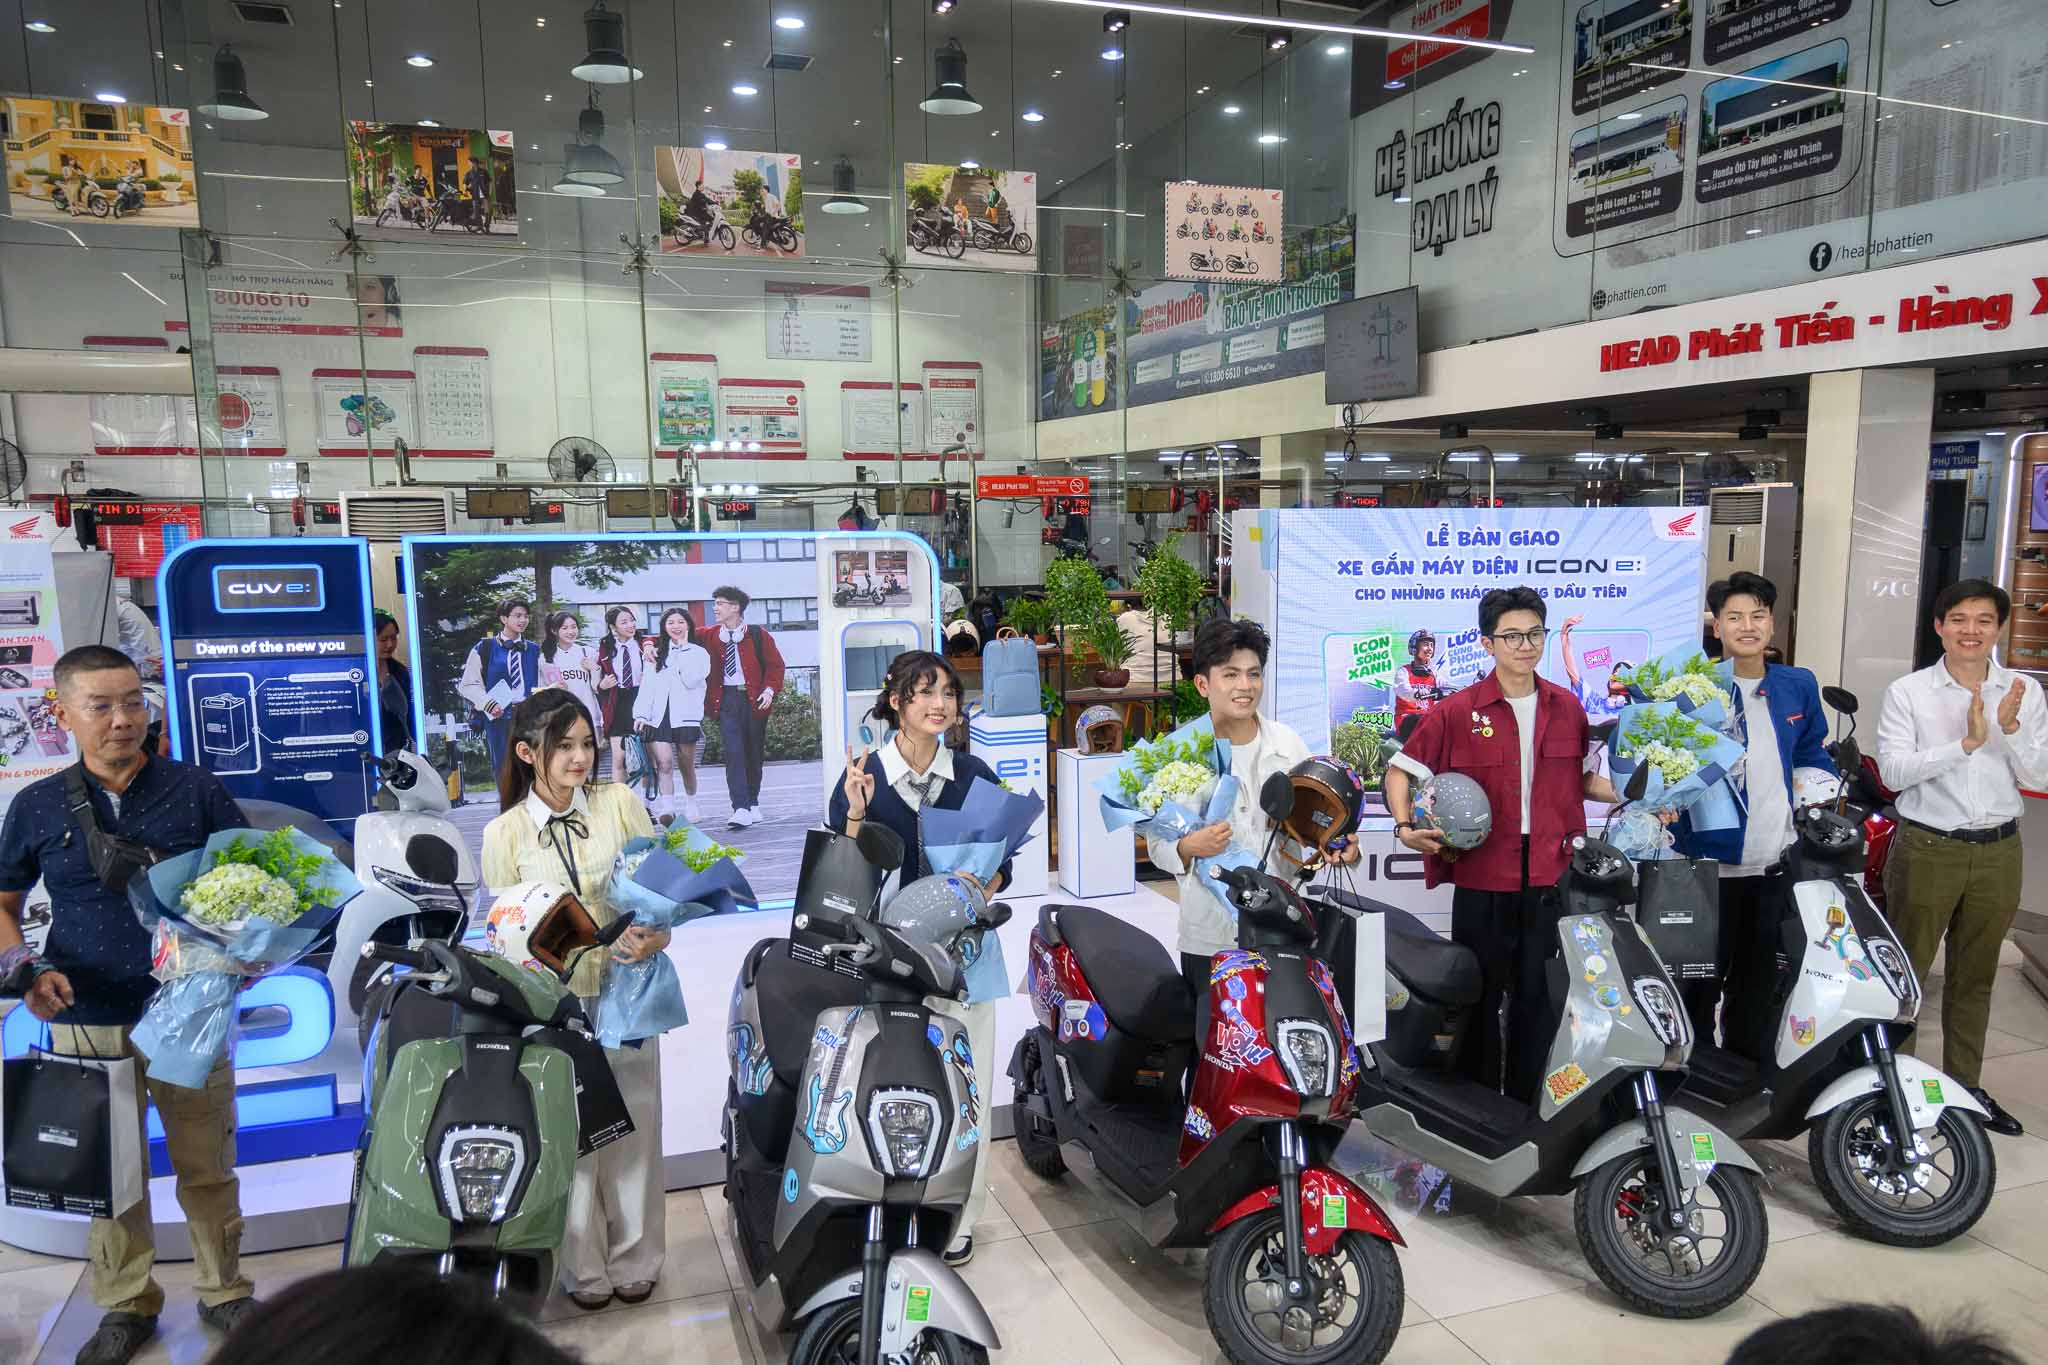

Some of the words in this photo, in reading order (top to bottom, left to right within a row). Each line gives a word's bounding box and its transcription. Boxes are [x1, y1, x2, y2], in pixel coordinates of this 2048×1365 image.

[1412, 97, 1501, 184] THỐNG
[1712, 164, 1734, 180] Honda
[1734, 161, 1747, 174] Ôtô
[1747, 157, 1760, 171] Tây
[1760, 152, 1778, 167] Ninh
[1783, 147, 1798, 160] Hòa
[1413, 189, 1458, 257] ĐẠI
[1464, 166, 1499, 237] LÝ
[1614, 195, 1628, 208] Long
[1835, 230, 1933, 262] /headphattien
[1607, 281, 1667, 306] phattien.com
[1167, 292, 1204, 328] Honda
[1600, 335, 1680, 373] HEAD
[1688, 322, 1763, 361] Phát
[1775, 301, 1855, 348] Tiến
[1898, 285, 2014, 331] Hàng
[1945, 445, 1965, 454] KHO
[1426, 522, 1449, 547] LỄ
[1457, 526, 1500, 547] BÀN
[1337, 560, 1363, 576] XE
[1371, 552, 1414, 576] GẮN
[1422, 555, 1465, 576] MÁY
[1527, 558, 1608, 574] ICON
[228, 583, 282, 595] CUV
[1355, 588, 1386, 601] CHO
[1391, 583, 1445, 601] NHỮNG
[1450, 585, 1496, 600] KHÁC
[1554, 582, 1586, 598] ĐẦU
[196, 643, 239, 655] Dawn
[241, 640, 258, 654] of
[258, 640, 284, 654] the
[286, 641, 316, 653] new
[318, 640, 346, 655] you
[1447, 628, 1481, 649] LƯỚ
[1348, 660, 1392, 681] XANH
[890, 1010, 920, 1019] HONDA
[815, 1025, 840, 1049] COOL
[1204, 1052, 1235, 1073] HONDA
